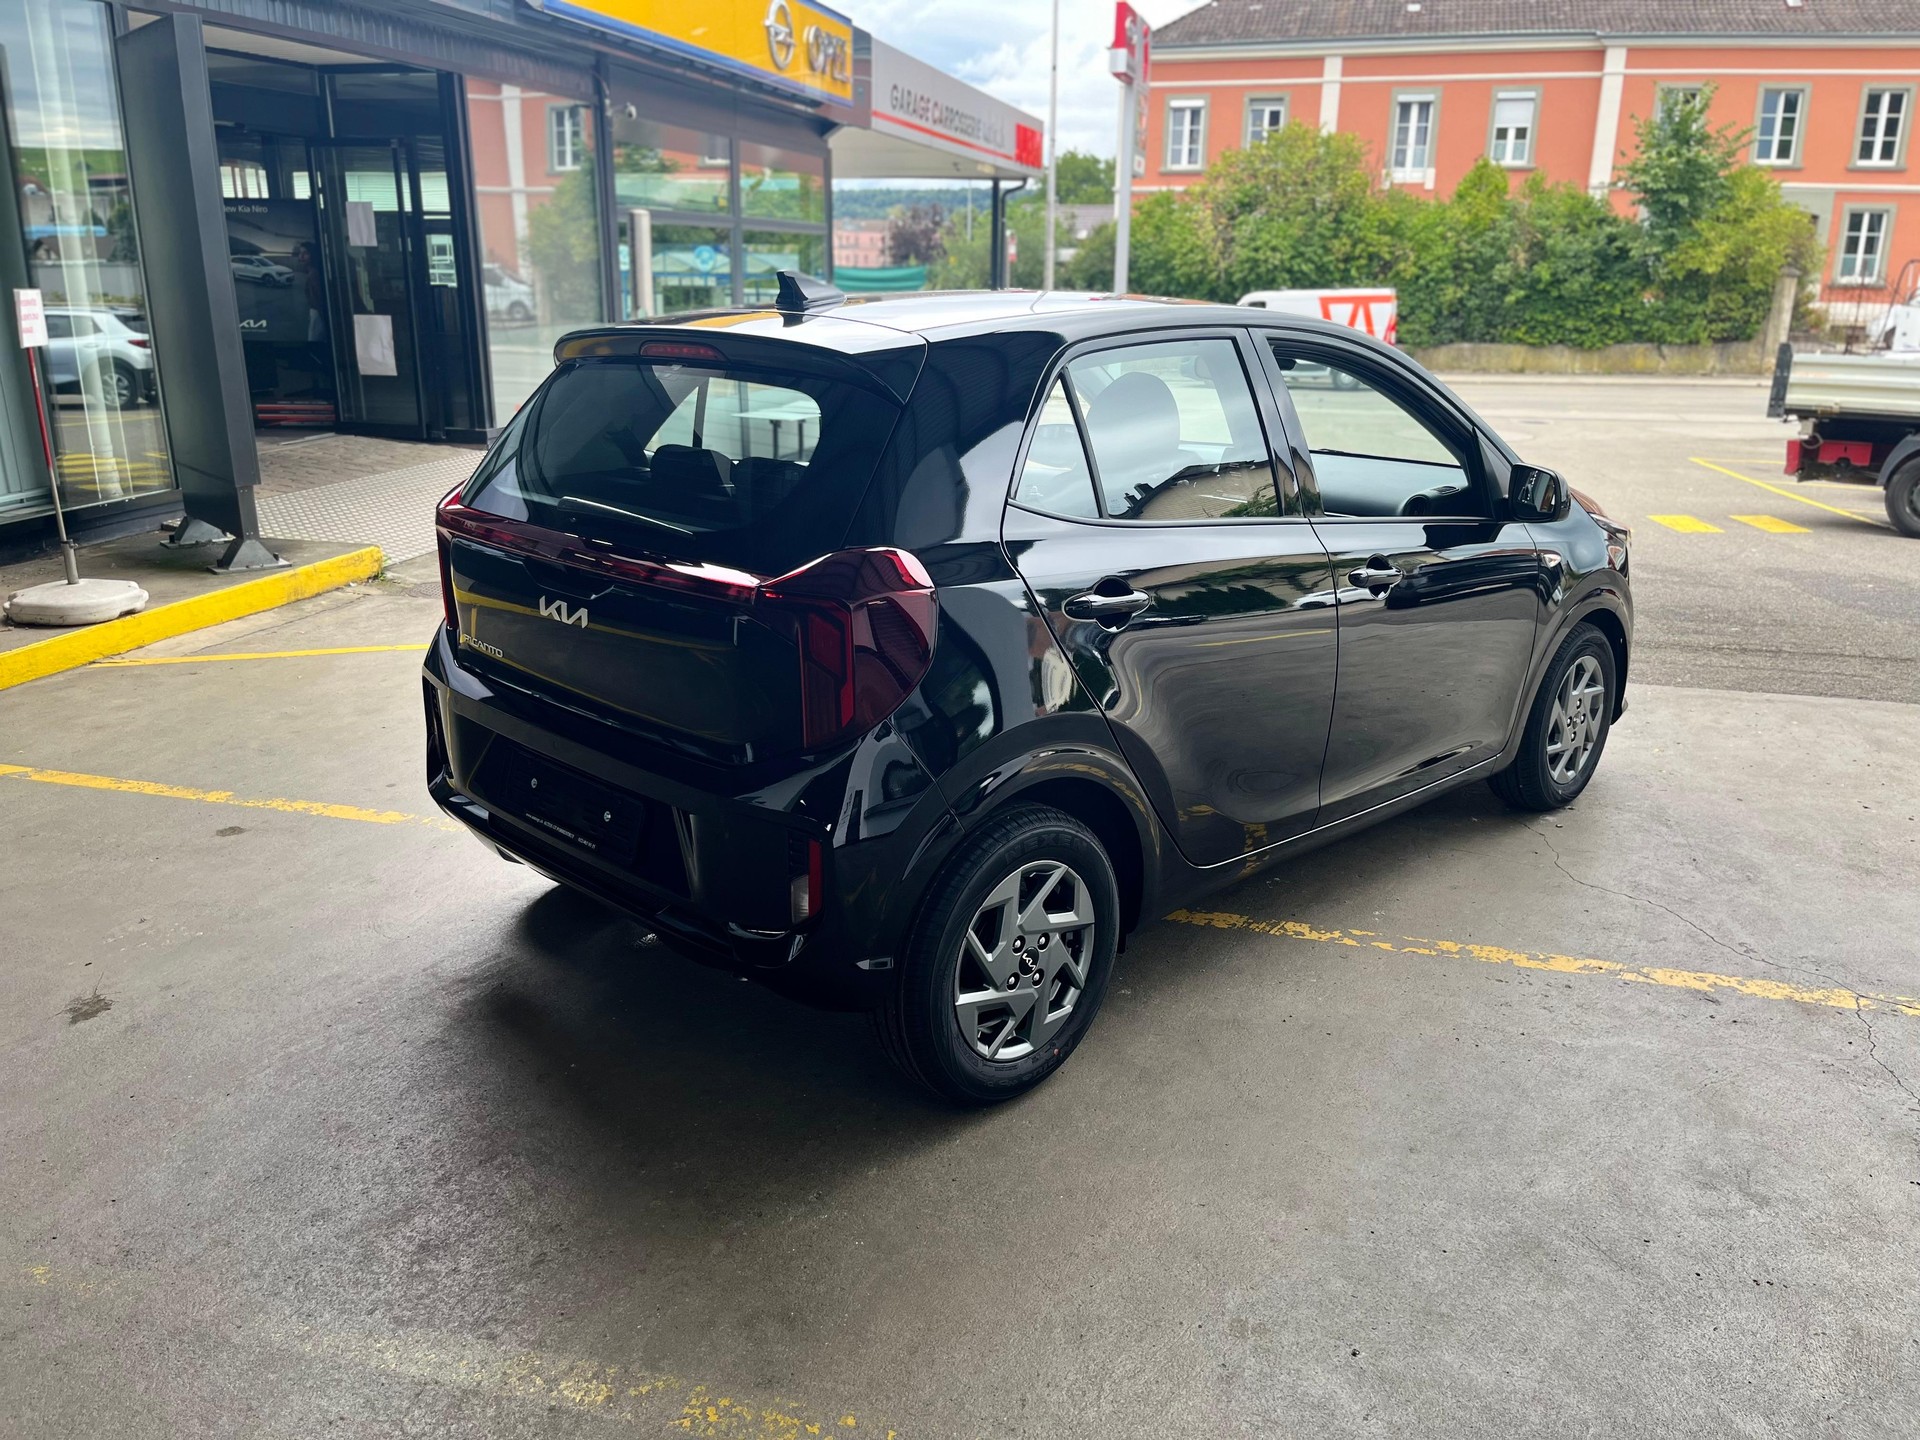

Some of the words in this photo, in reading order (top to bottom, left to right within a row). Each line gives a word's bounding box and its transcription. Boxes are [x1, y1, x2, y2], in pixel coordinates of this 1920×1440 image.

[804, 25, 848, 82] OPEL
[890, 83, 931, 122] GARAGE
[931, 101, 981, 140] CARROSSERIE
[238, 205, 251, 213] Kia
[252, 205, 268, 214] Niro
[539, 595, 588, 629] KIA
[463, 633, 504, 658] PICANTO
[1004, 832, 1088, 863] NEXEN
